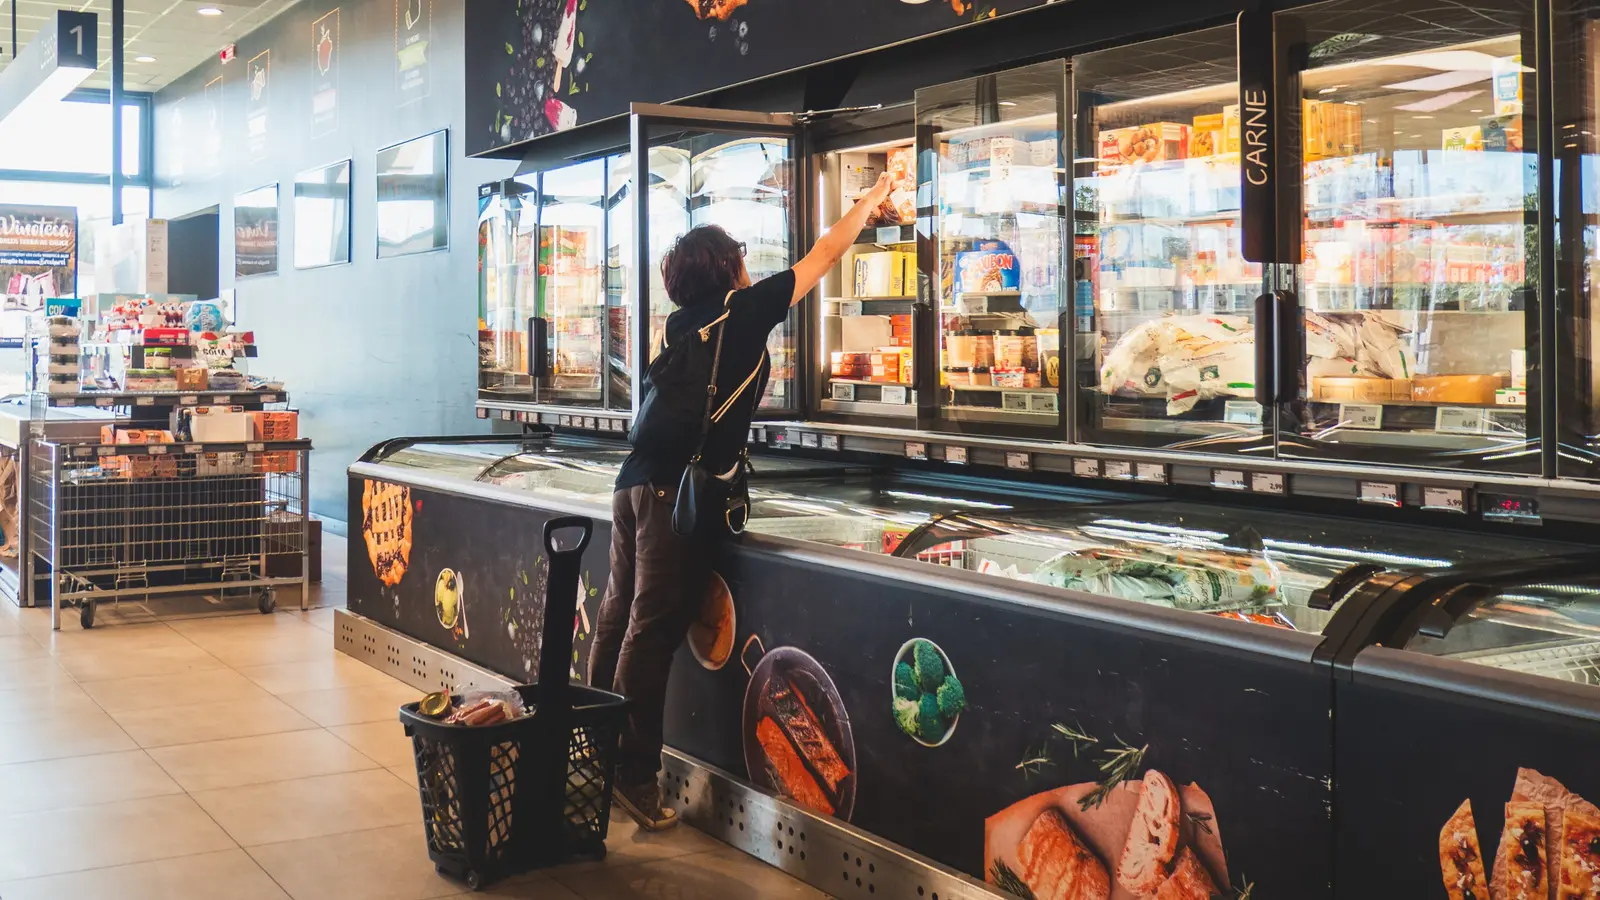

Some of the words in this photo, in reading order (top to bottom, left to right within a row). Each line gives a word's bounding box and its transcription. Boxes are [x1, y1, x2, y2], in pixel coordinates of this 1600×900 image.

[69, 25, 83, 56] 1
[1245, 89, 1268, 185] CARNE
[0, 214, 72, 239] Vinoteca
